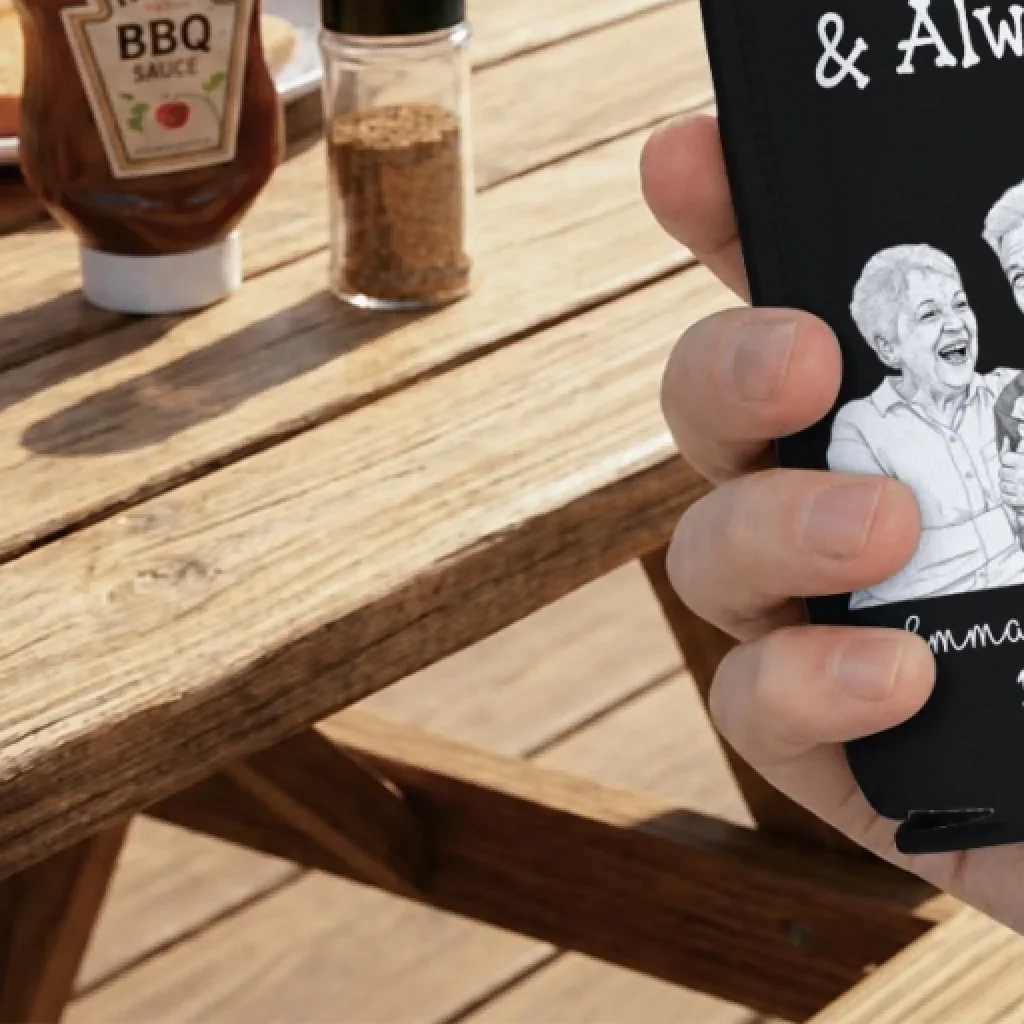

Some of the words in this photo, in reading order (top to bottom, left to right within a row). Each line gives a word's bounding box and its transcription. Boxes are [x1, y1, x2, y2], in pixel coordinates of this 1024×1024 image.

[117, 13, 211, 60] BBQ
[815, 11, 871, 91] &
[133, 57, 200, 84] SAUCE
